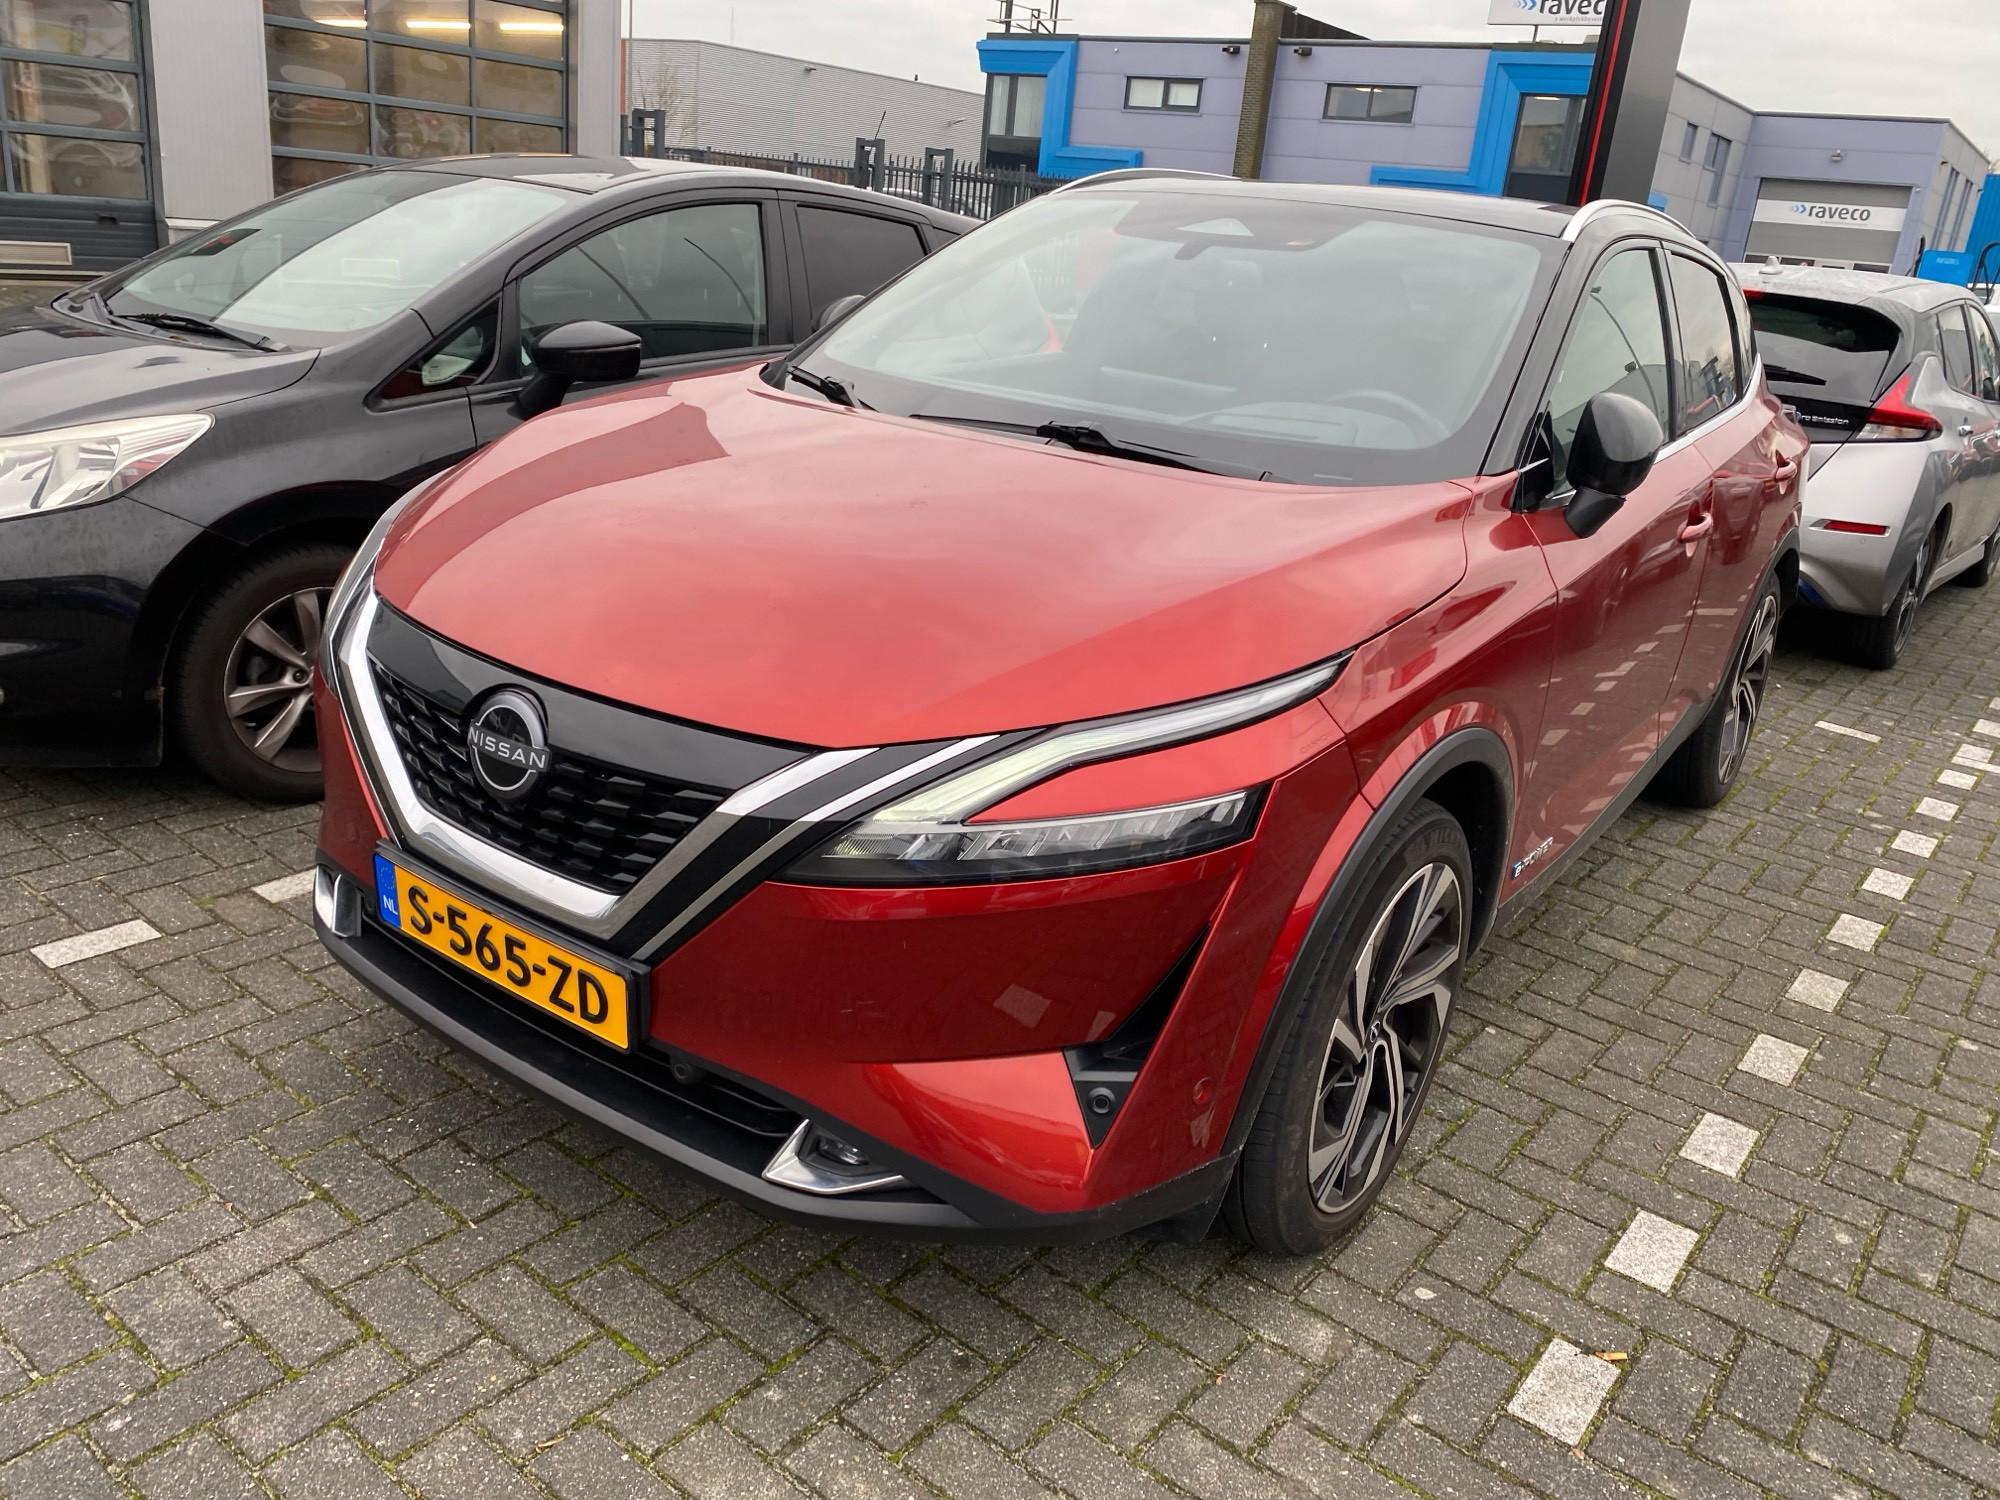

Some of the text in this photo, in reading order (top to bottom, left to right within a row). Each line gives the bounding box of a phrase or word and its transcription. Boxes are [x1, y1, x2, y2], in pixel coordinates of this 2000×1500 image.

[1540, 0, 1603, 15] ravec
[1808, 205, 1871, 221] raveco
[468, 726, 546, 769] NISSAN
[383, 894, 399, 916] NL
[408, 885, 609, 1025] S-565-ZD
